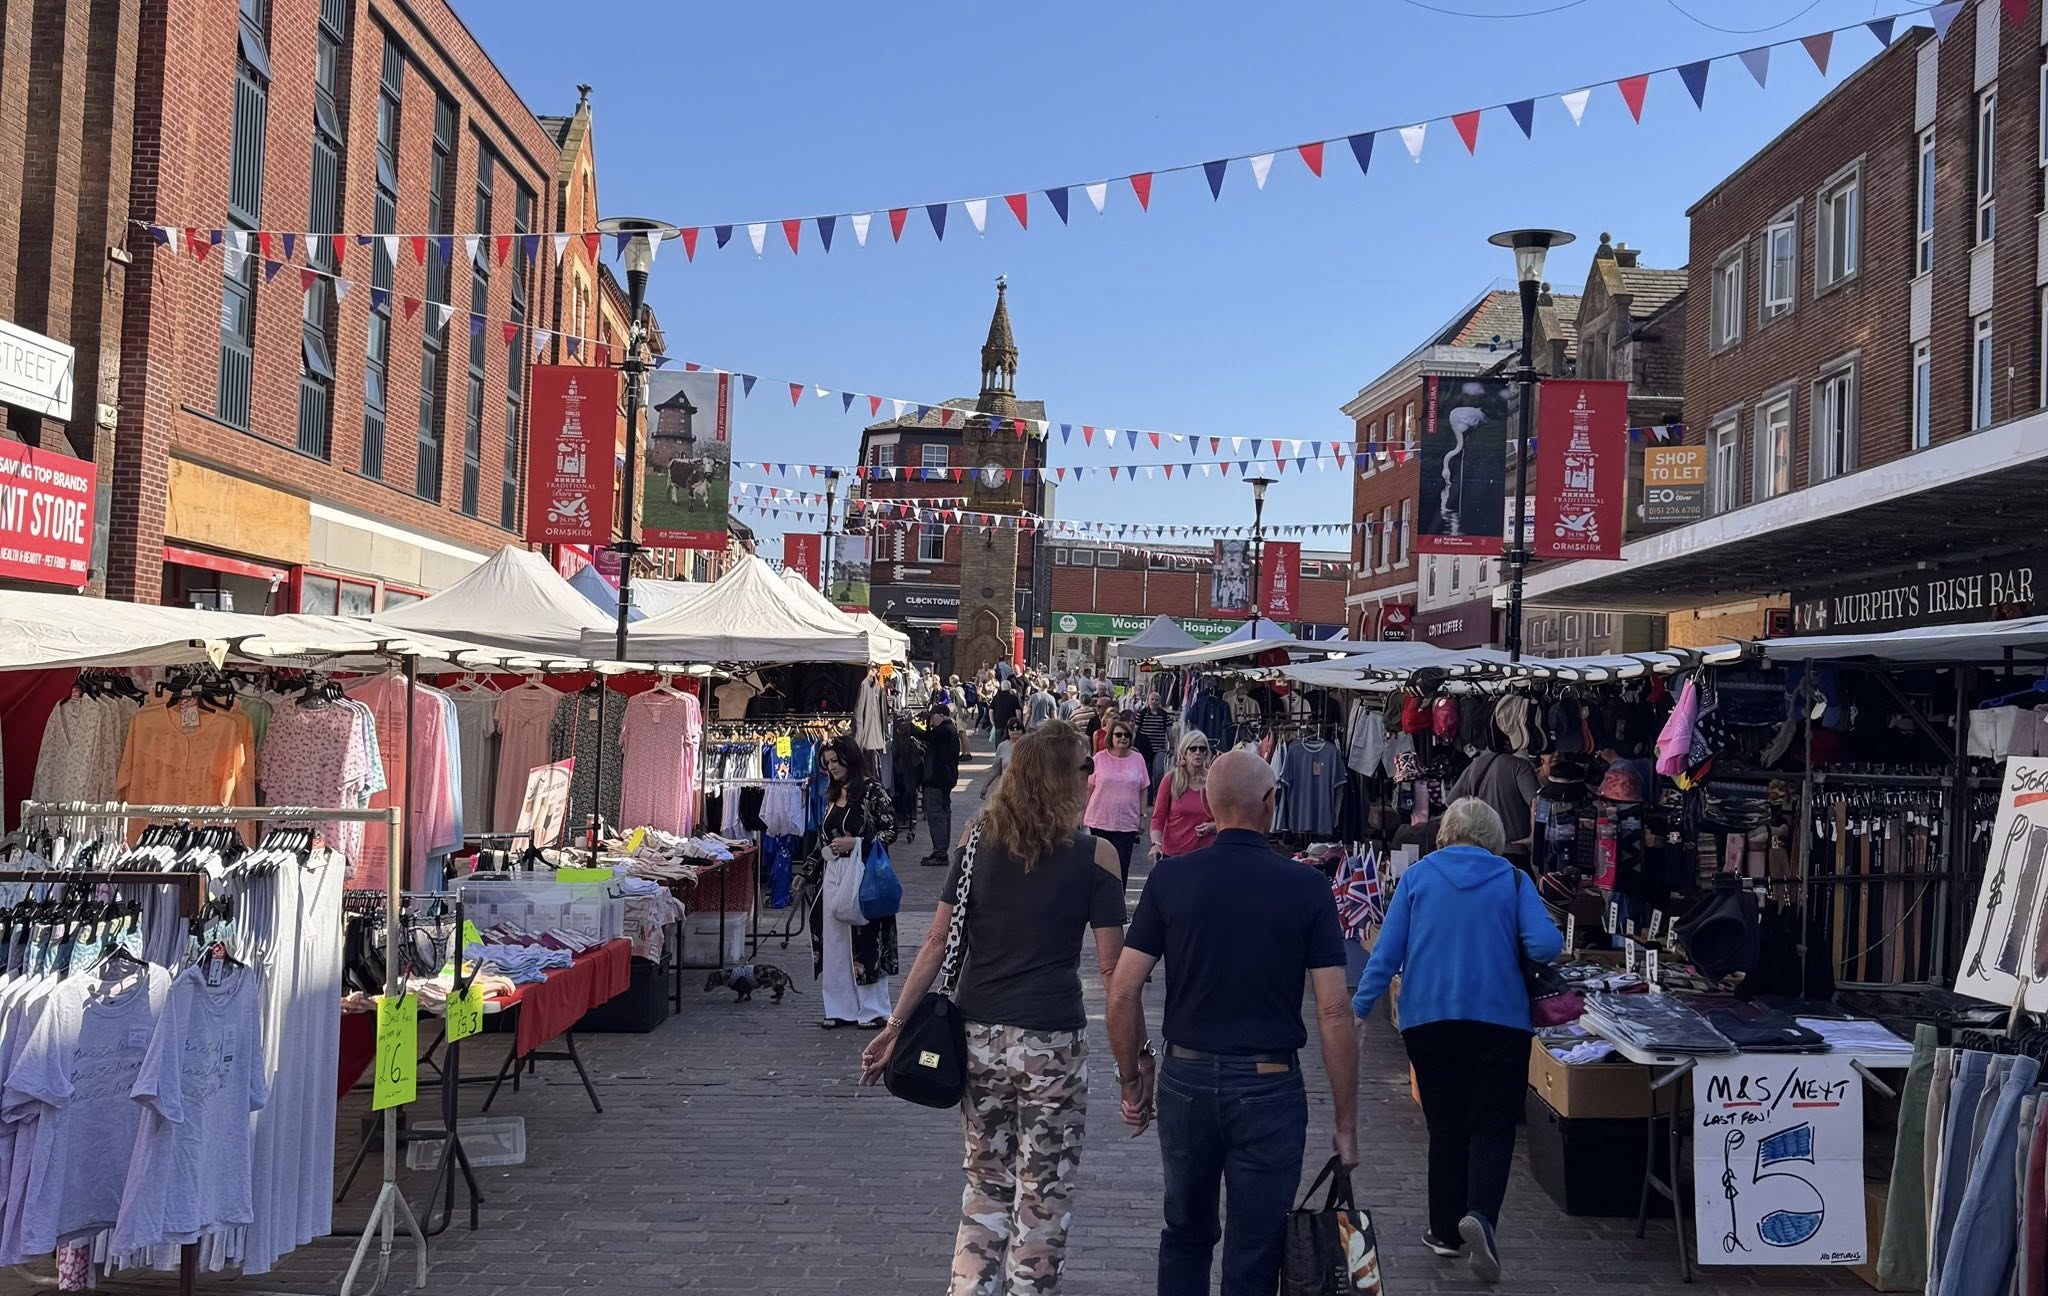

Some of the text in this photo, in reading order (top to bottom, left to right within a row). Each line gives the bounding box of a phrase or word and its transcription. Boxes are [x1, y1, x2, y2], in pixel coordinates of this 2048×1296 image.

[0, 341, 57, 385] TREET
[1656, 452, 1697, 465] SHOP
[33, 466, 53, 484] TOP
[53, 473, 88, 493] BRANDS
[1650, 467, 1702, 480] TO LET
[545, 482, 597, 490] TRADITIONAL
[0, 484, 87, 545] NT STORE
[1649, 507, 1664, 515] 0151
[545, 528, 593, 537] ORMSKIRK
[1552, 542, 1602, 551] ORMSKIRK
[905, 596, 961, 606] CLOCKTOWER
[1834, 567, 2035, 625] MURPHY'S IRISH BAR
[1183, 621, 1232, 635] Hospice
[1428, 619, 1463, 638] COSTA COFFEE
[1703, 1112, 1737, 1127] LAST
[1820, 1252, 1861, 1261] NO RETURNS
